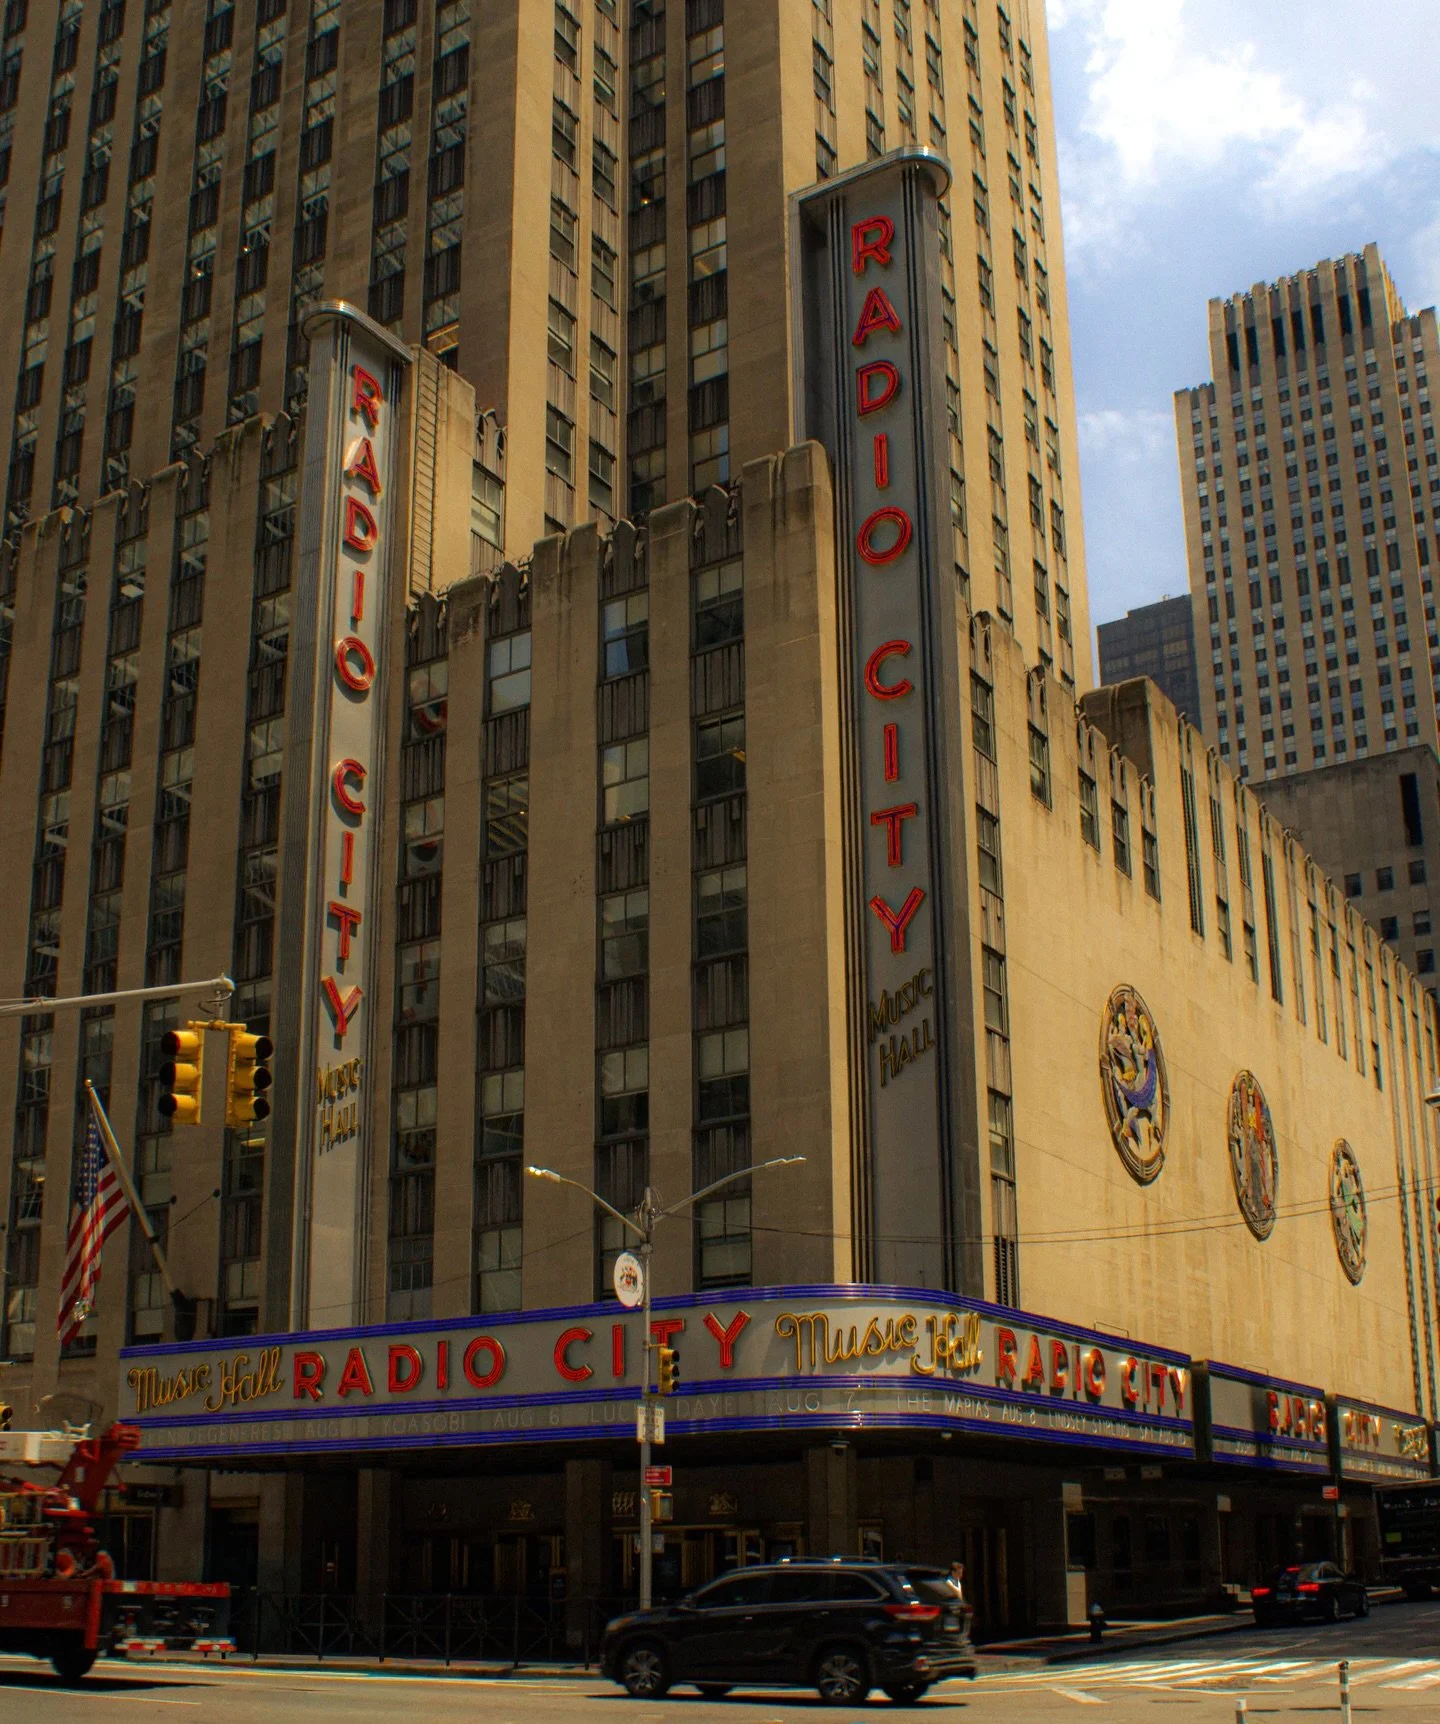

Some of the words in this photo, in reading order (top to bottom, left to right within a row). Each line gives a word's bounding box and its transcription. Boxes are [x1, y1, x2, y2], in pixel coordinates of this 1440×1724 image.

[851, 214, 913, 567] RADIO
[336, 363, 384, 692] RADIO
[864, 638, 926, 954] CITY
[322, 758, 368, 1037] CITY
[879, 1018, 936, 1088] HALL
[321, 1102, 360, 1147] HALL
[128, 1366, 212, 1413] Music
[204, 1346, 285, 1413] Hall
[293, 1335, 506, 1401] RADIO
[553, 1309, 751, 1383] CITY
[774, 1311, 919, 1371] Music
[911, 1312, 984, 1375] Hall
[994, 1325, 1107, 1397] RADIO
[1121, 1356, 1189, 1411] CITY
[493, 1408, 534, 1429] AUG
[548, 1406, 560, 1426] 6
[676, 1393, 738, 1419] DAYE
[766, 1391, 820, 1414] AUG
[1001, 1403, 1022, 1423] AUG
[1265, 1390, 1328, 1436] RADIO
